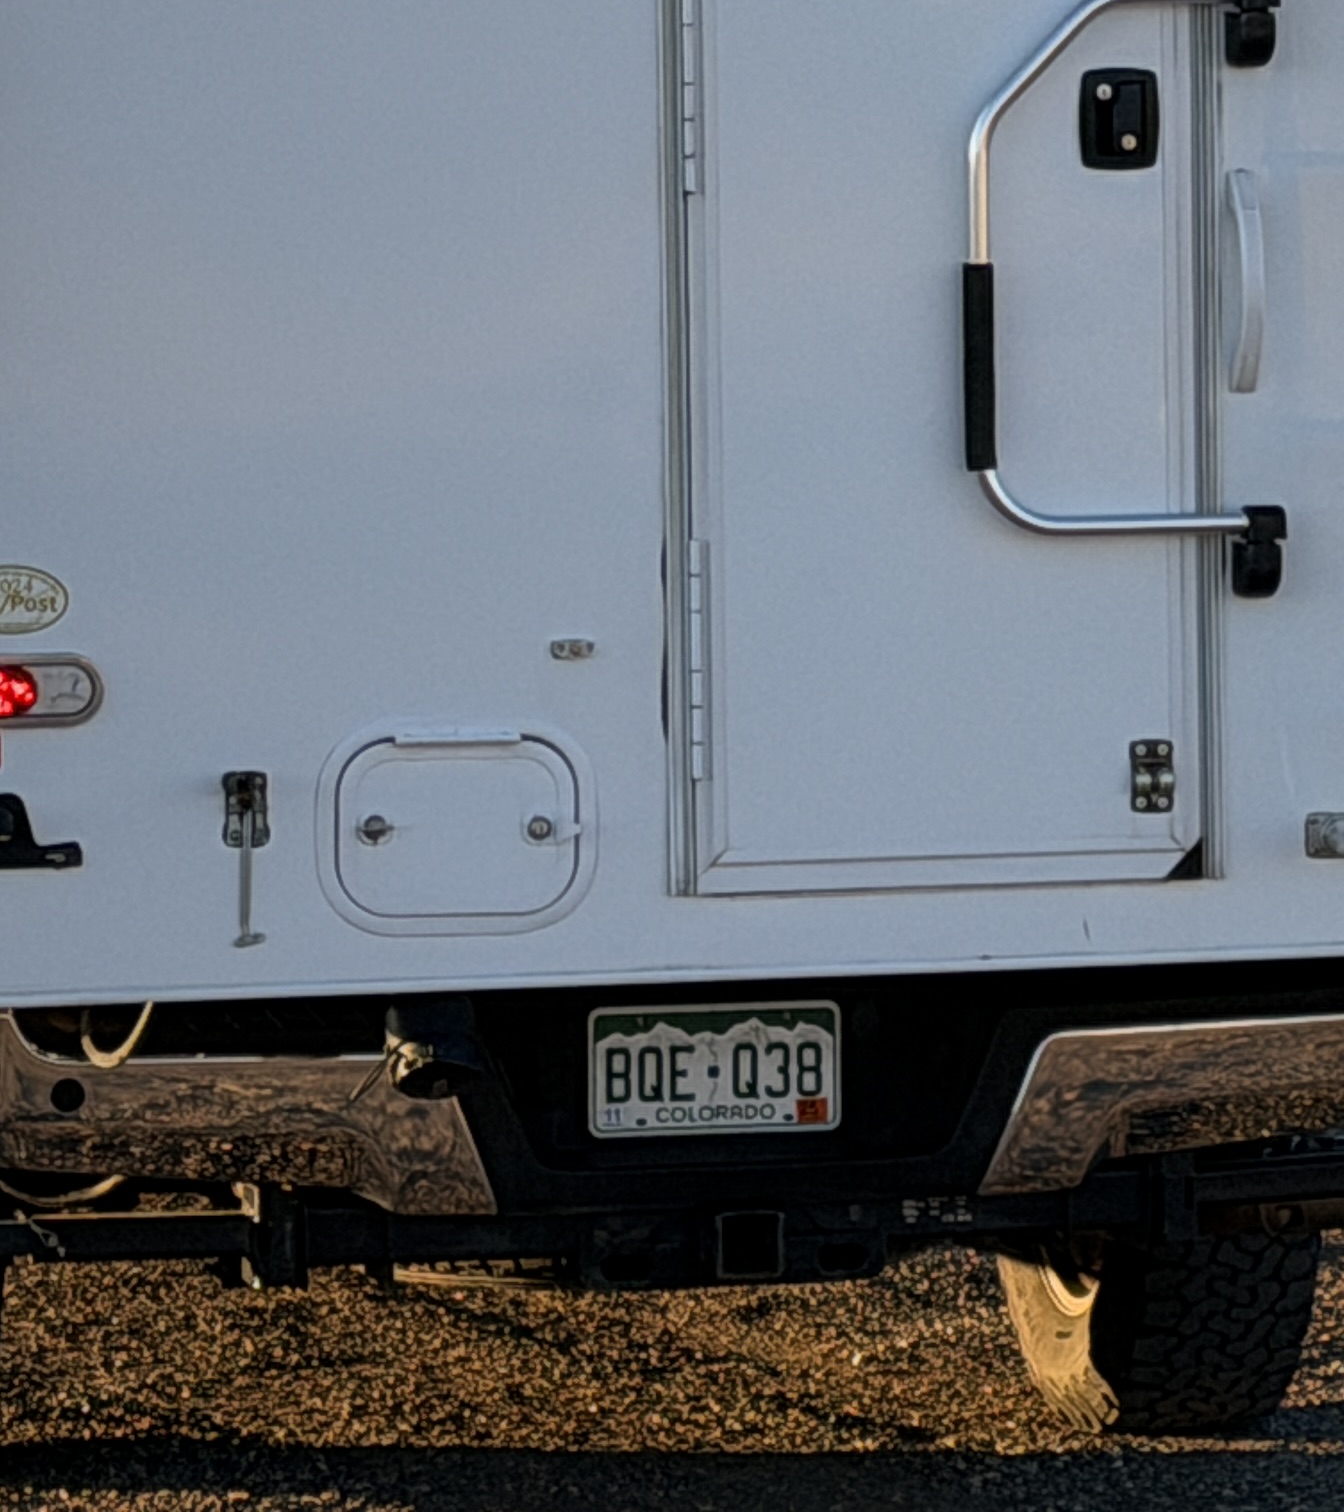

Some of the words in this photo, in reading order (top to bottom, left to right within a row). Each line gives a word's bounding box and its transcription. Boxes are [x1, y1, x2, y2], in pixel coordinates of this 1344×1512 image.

[605, 1046, 696, 1104] BQE
[731, 1041, 823, 1100] Q38
[655, 1102, 777, 1124] COLORADO
